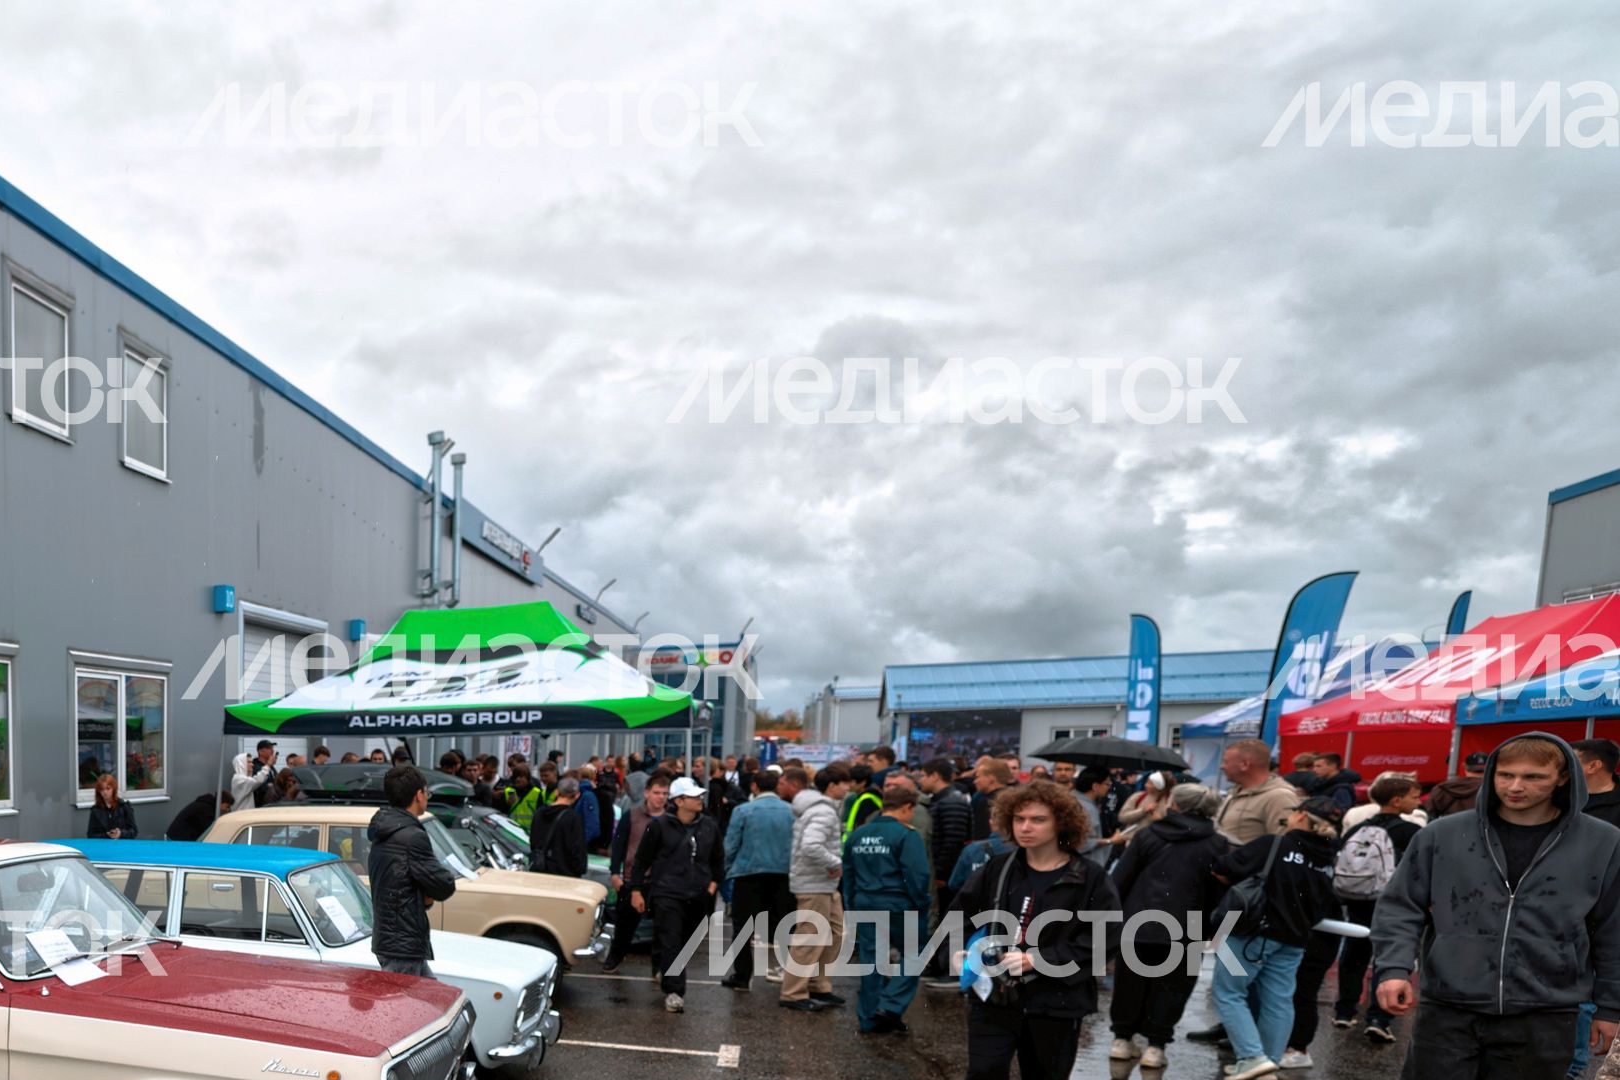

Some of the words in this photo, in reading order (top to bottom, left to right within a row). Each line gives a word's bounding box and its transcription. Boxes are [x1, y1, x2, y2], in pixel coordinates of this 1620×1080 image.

[349, 713, 453, 728] ALPHARD
[461, 710, 543, 725] GROUP
[1283, 851, 1304, 864] JS
